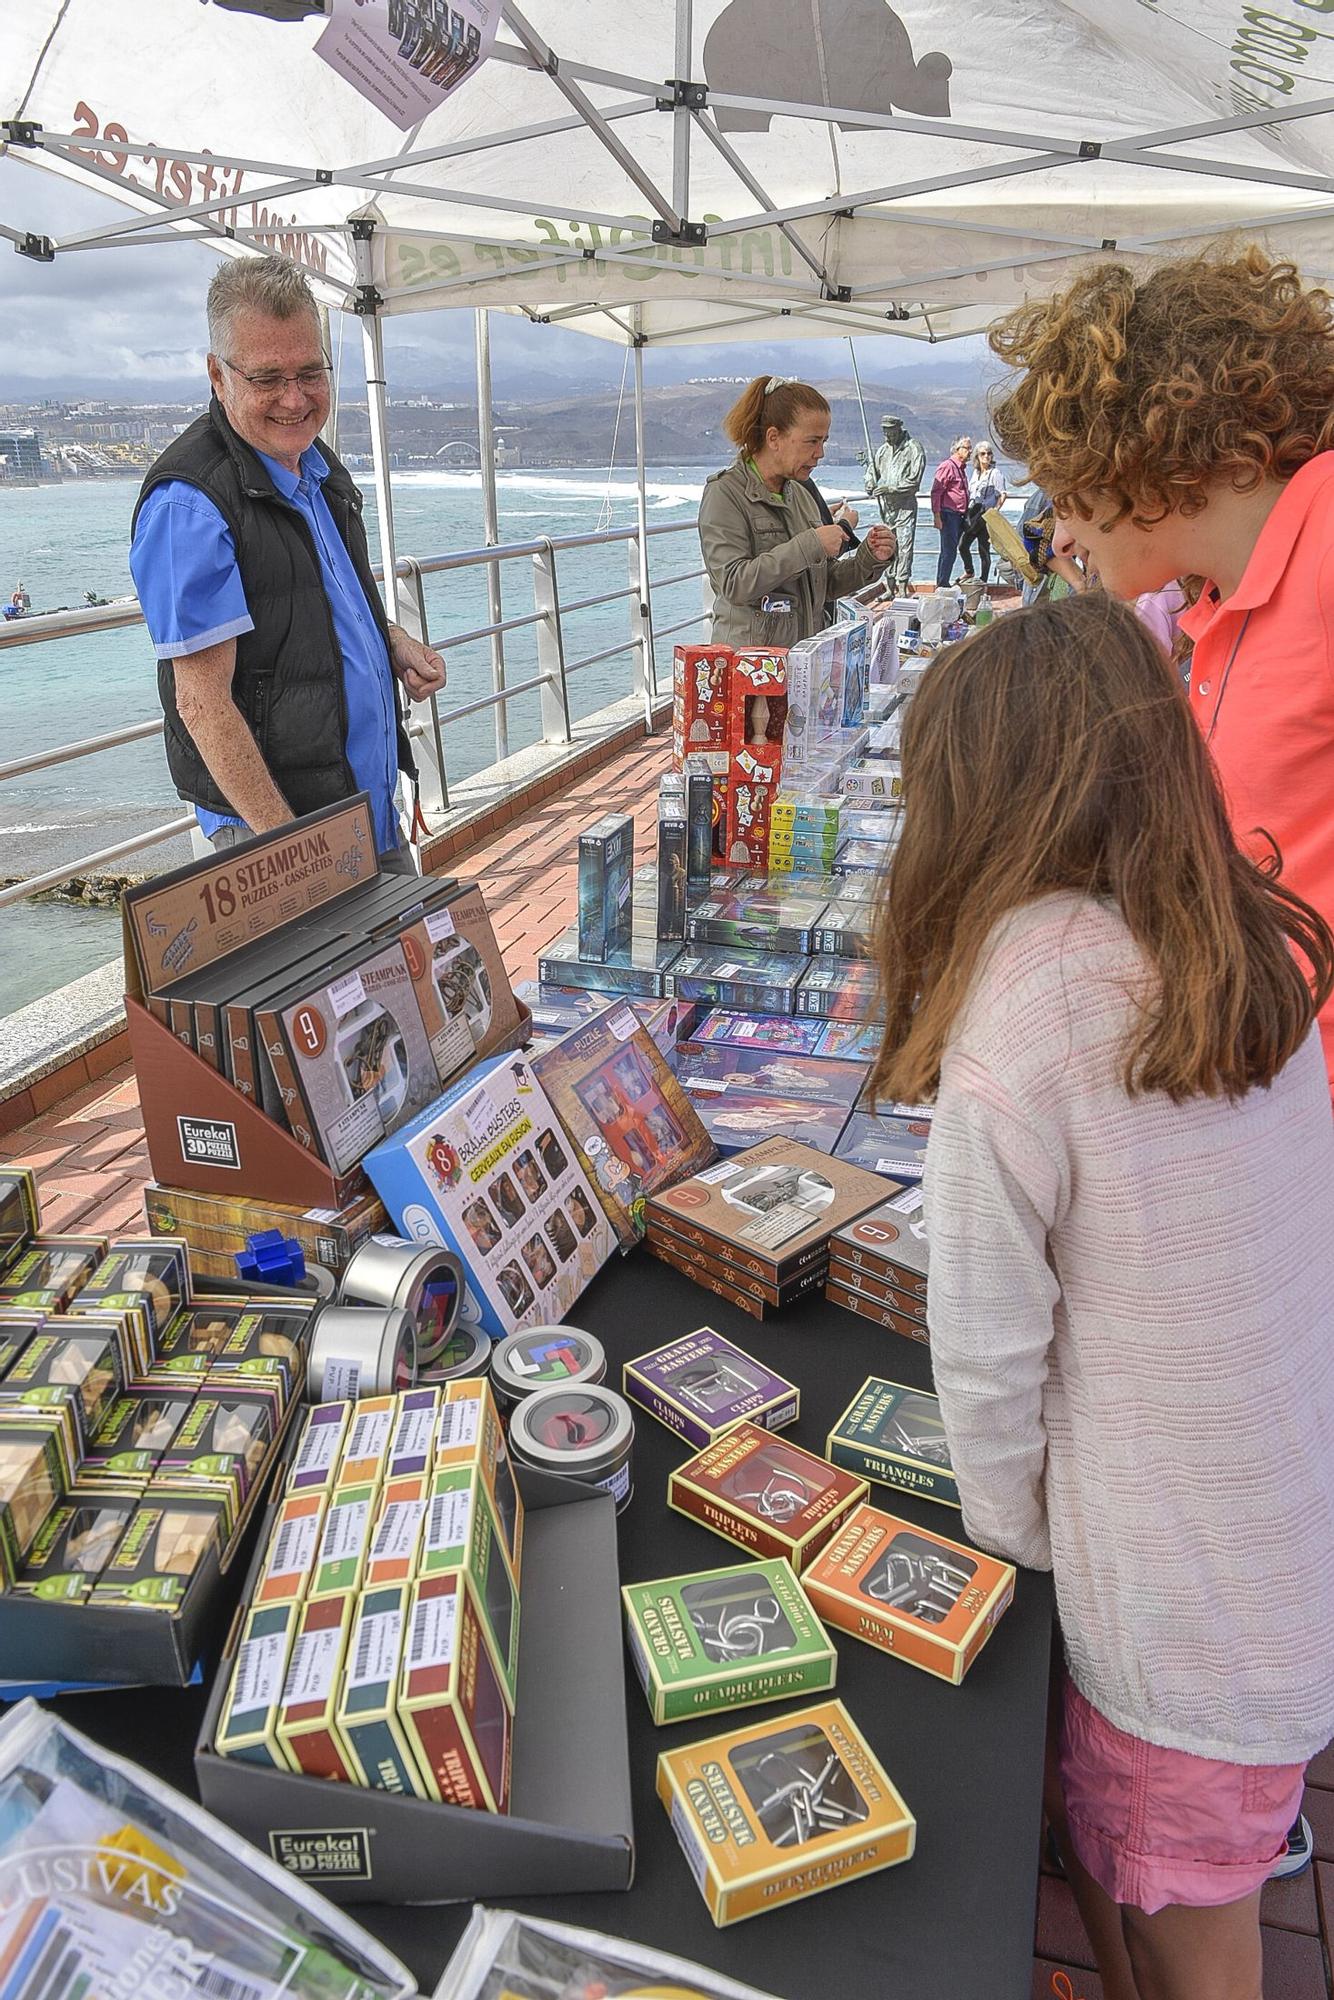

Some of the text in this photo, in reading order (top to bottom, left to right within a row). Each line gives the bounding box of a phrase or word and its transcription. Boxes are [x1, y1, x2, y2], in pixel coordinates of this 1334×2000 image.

[200, 831, 331, 925] 18 STEAMPUNK
[241, 880, 279, 908] PUZZLES
[285, 855, 334, 888] CASSE-TÊTES
[451, 906, 486, 922] TEAMPUNK
[824, 930, 835, 951] EXIT
[405, 940, 419, 972] 9
[809, 991, 820, 1013] EXIT
[299, 1012, 319, 1049] 9
[573, 1026, 602, 1053] PUZZLE
[184, 1122, 230, 1140] Eureka!
[187, 1139, 206, 1154] 3D
[436, 1149, 451, 1172] 8
[738, 1141, 796, 1165] STEAMPUNK
[673, 1190, 700, 1204] 9
[413, 1218, 430, 1239] IQ
[859, 1224, 890, 1240] 9
[656, 1341, 697, 1363] GRAND
[659, 1344, 714, 1374] MASTERS
[653, 1398, 685, 1429] CLAMPS
[730, 1393, 765, 1413] CLAMPS
[849, 1394, 875, 1424] GRAND
[861, 1392, 894, 1434] MASTERS
[700, 1435, 739, 1467] GRAND
[706, 1437, 760, 1478] MASTERS
[863, 1457, 935, 1488] TRIANGLES
[802, 1488, 840, 1521] TRIPLETS
[703, 1504, 758, 1543] TRIPLETS
[829, 1526, 864, 1564] GRAND
[841, 1526, 886, 1577] MASTERS
[642, 1608, 671, 1657] GRAND
[658, 1596, 695, 1661] MASTERS
[694, 1671, 805, 1704] QUADRUPLETS
[687, 1781, 727, 1844] GRAND
[701, 1762, 756, 1848] MASTERS
[280, 1834, 359, 1853] Eureka!
[283, 1853, 360, 1870] 3D PUZZEL
[318, 1860, 360, 1870] PUZZLE
